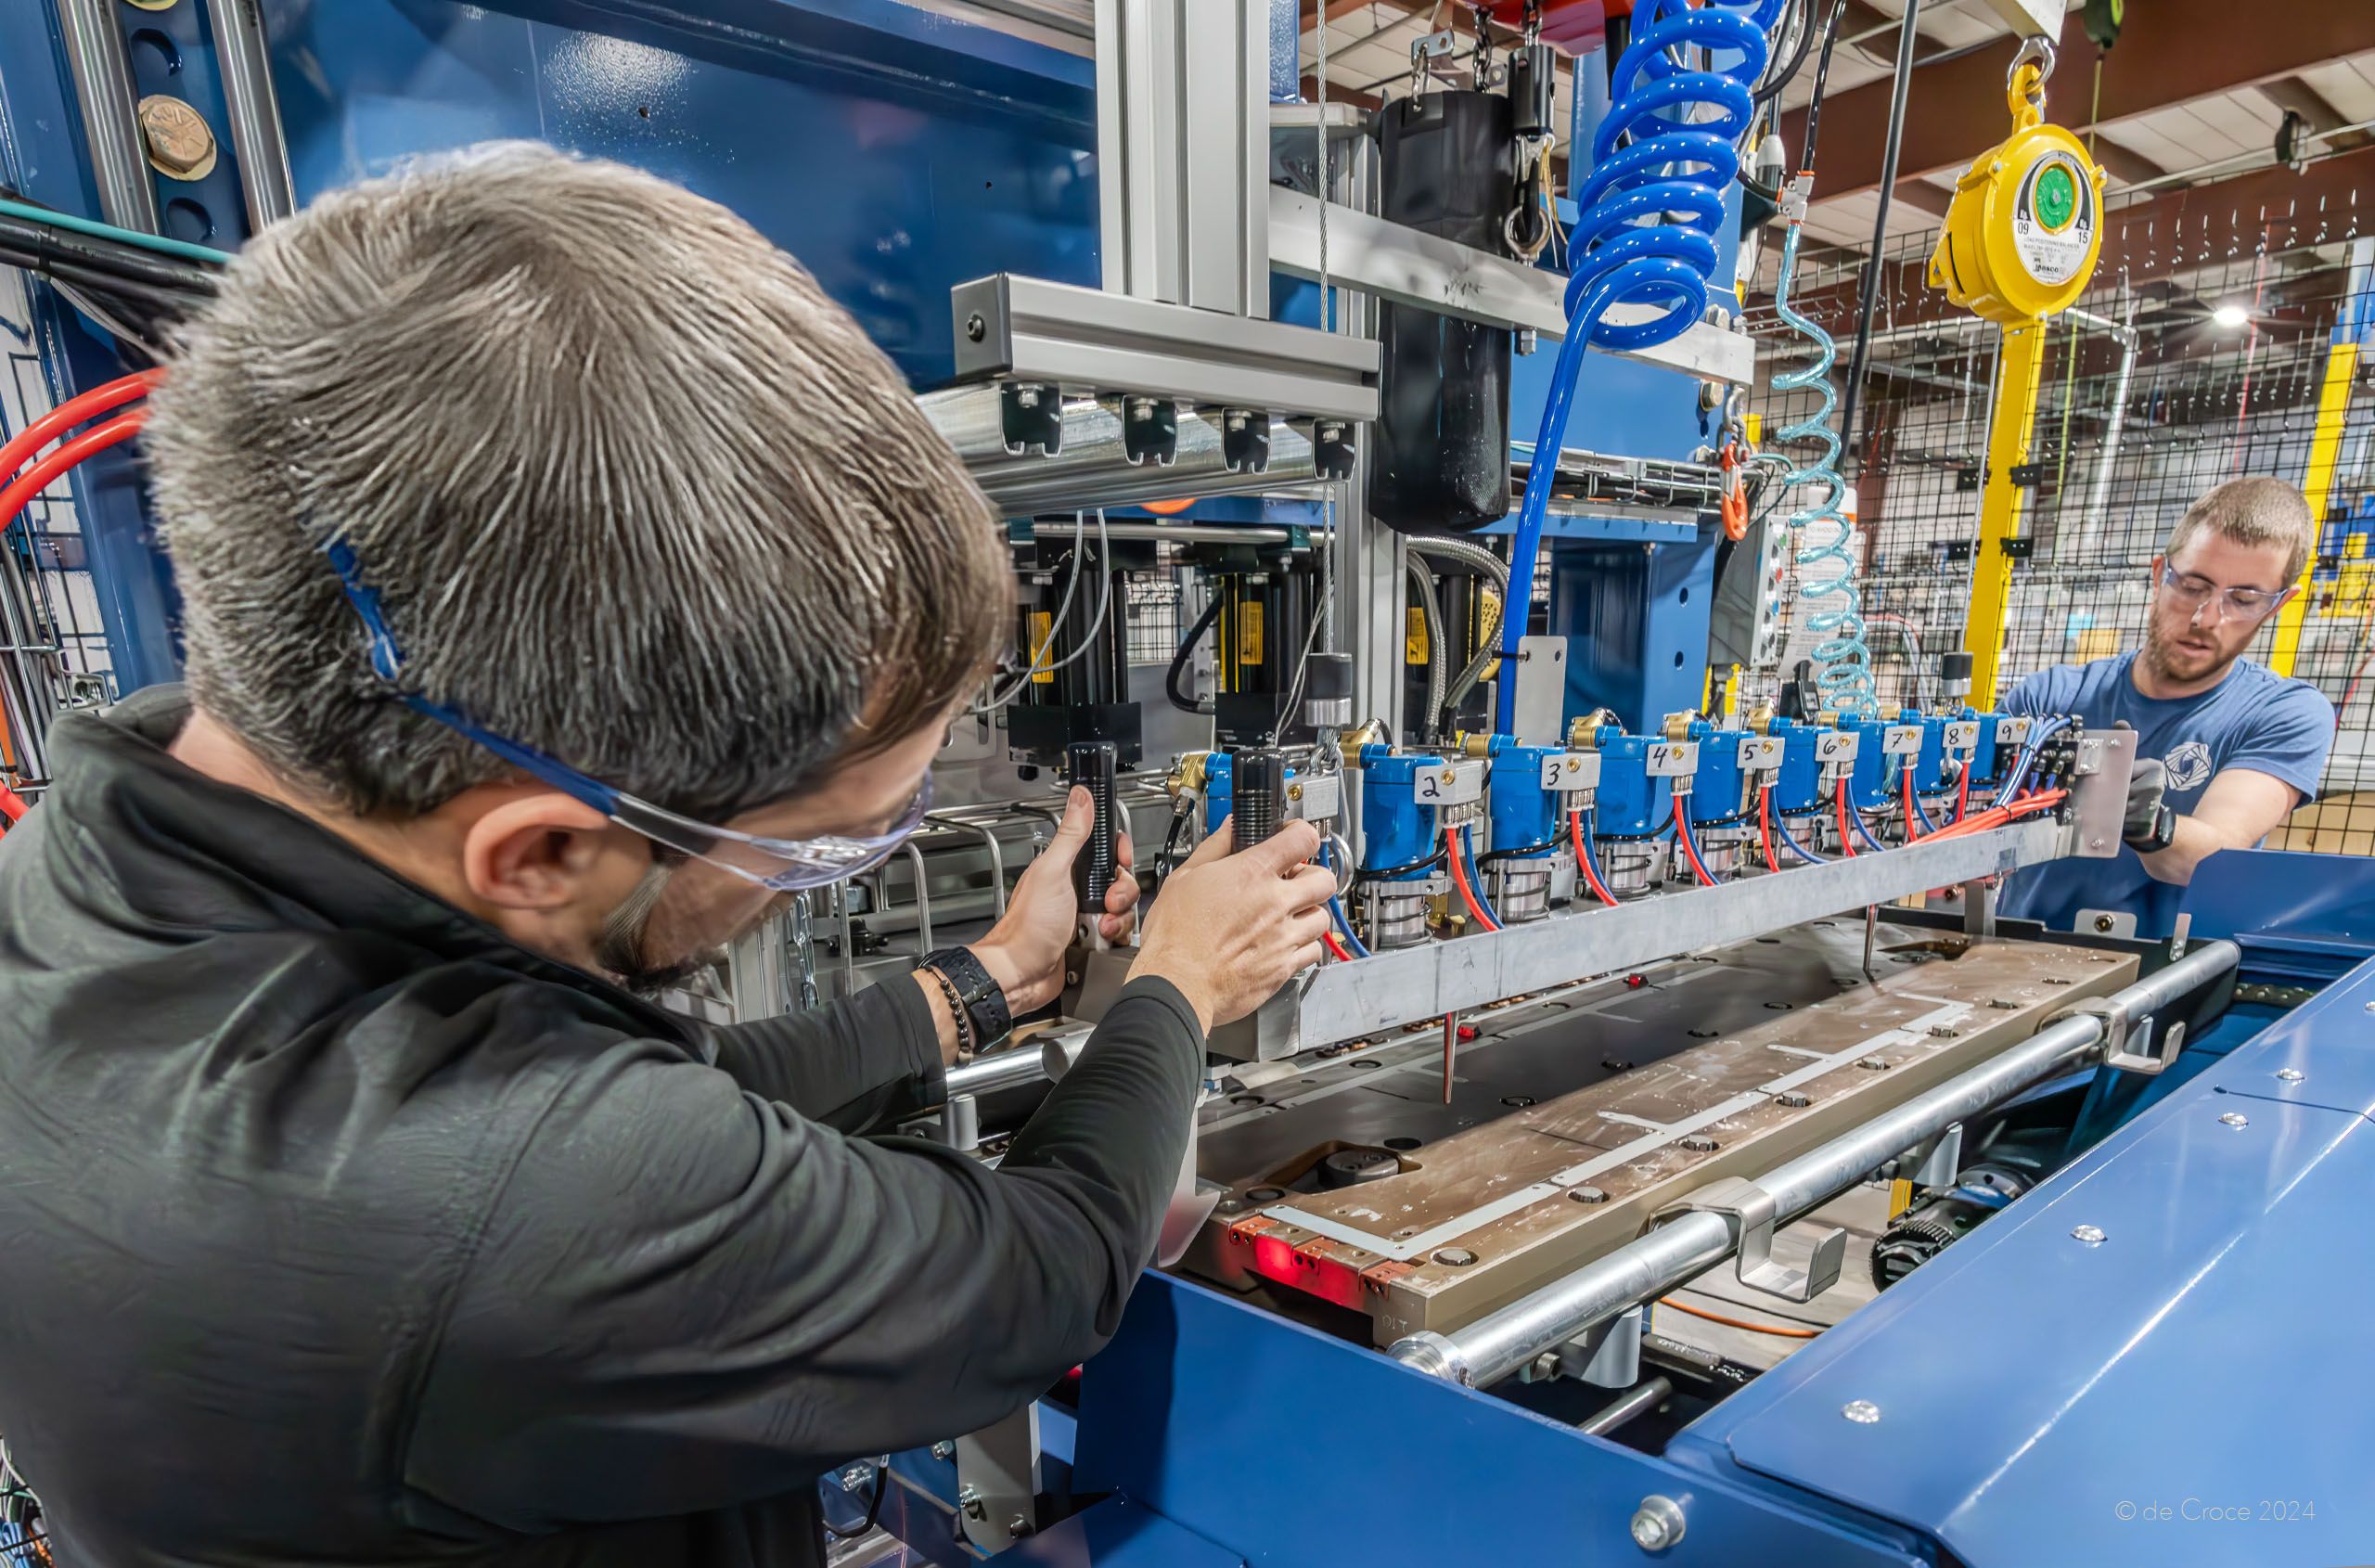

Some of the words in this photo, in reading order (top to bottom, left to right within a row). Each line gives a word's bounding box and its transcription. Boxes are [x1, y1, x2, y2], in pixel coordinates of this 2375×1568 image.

[2018, 222, 2029, 235] 09
[2078, 231, 2088, 244] 15
[1893, 732, 1904, 747] 7
[1948, 728, 1959, 744] 8
[2002, 725, 2012, 740] 9
[1743, 744, 1759, 760] 5
[1822, 738, 1837, 754] 6
[1652, 746, 1668, 768] 4
[1547, 763, 1562, 786] 3
[1421, 776, 1441, 797] 2
